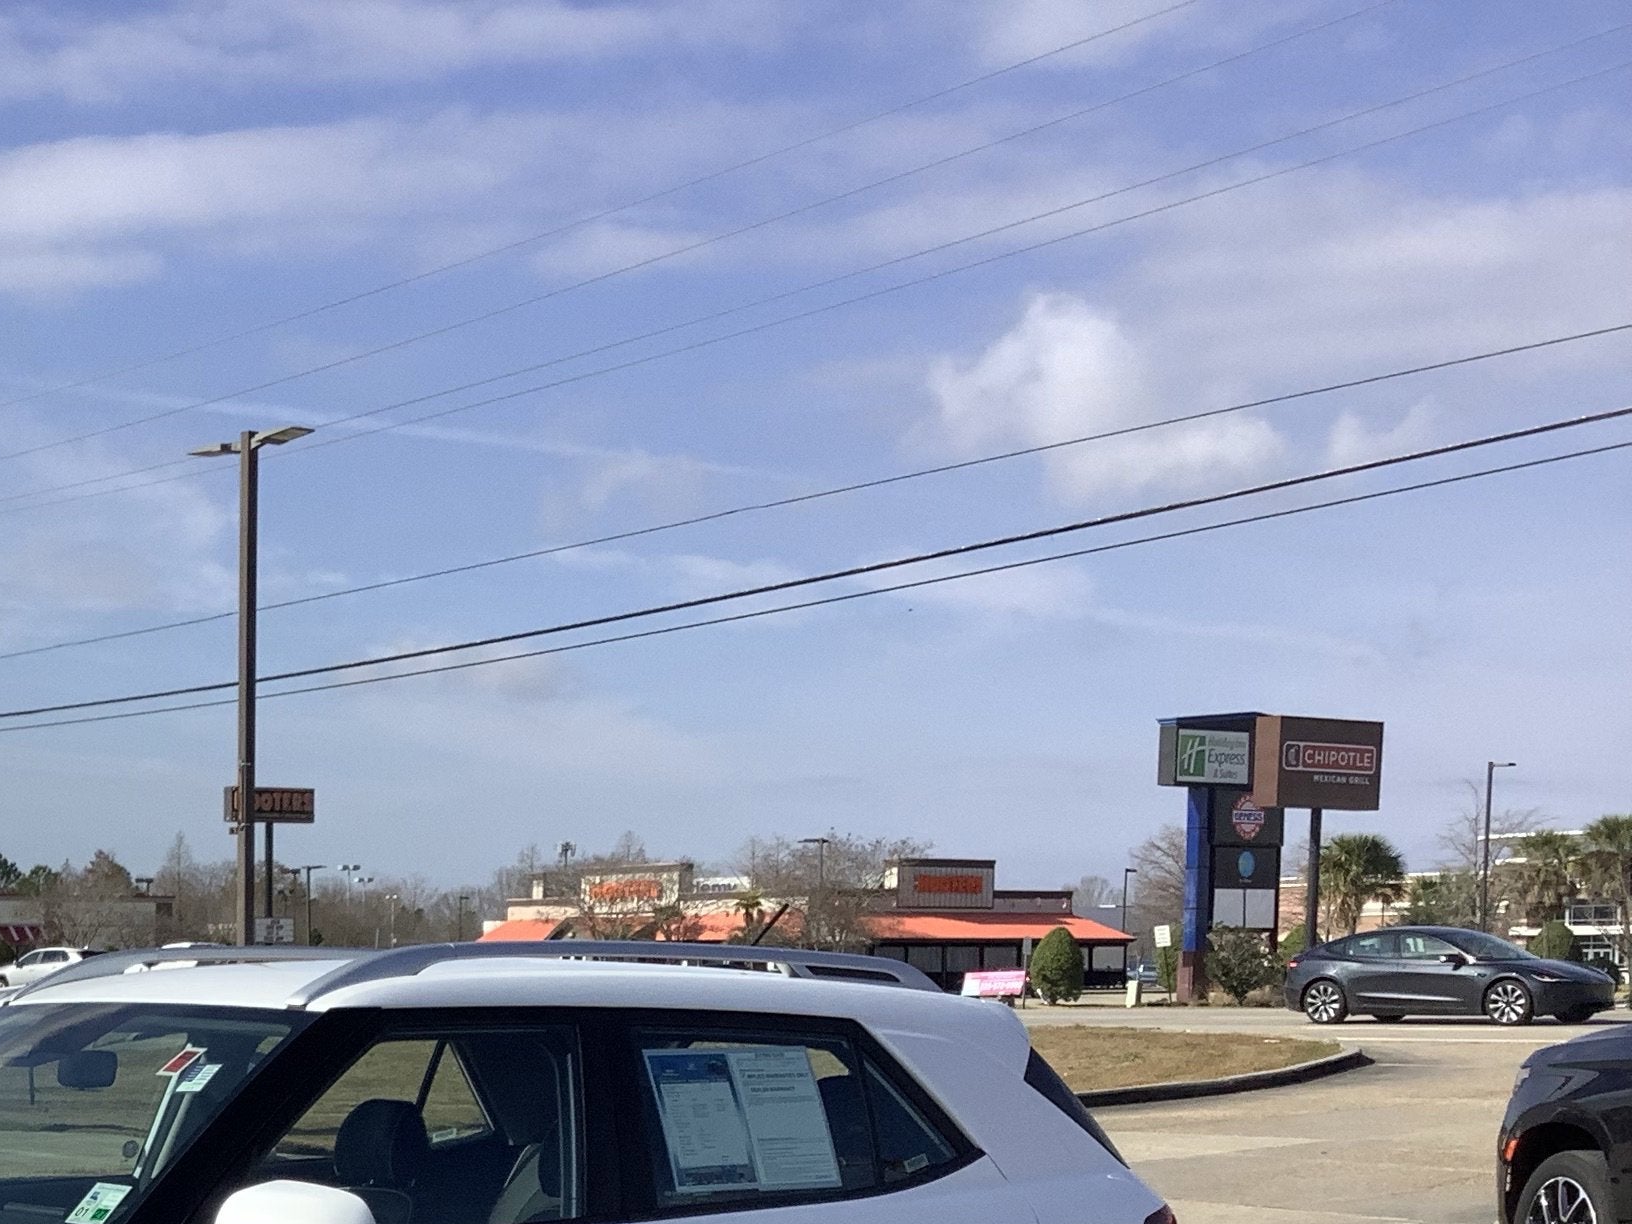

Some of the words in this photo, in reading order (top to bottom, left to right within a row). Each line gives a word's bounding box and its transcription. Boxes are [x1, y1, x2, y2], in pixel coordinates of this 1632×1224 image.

[1207, 748, 1246, 768] Express
[1304, 749, 1372, 767] CHIPOTLE
[1313, 774, 1347, 785] MEXICAN
[1348, 776, 1370, 785] GRILL
